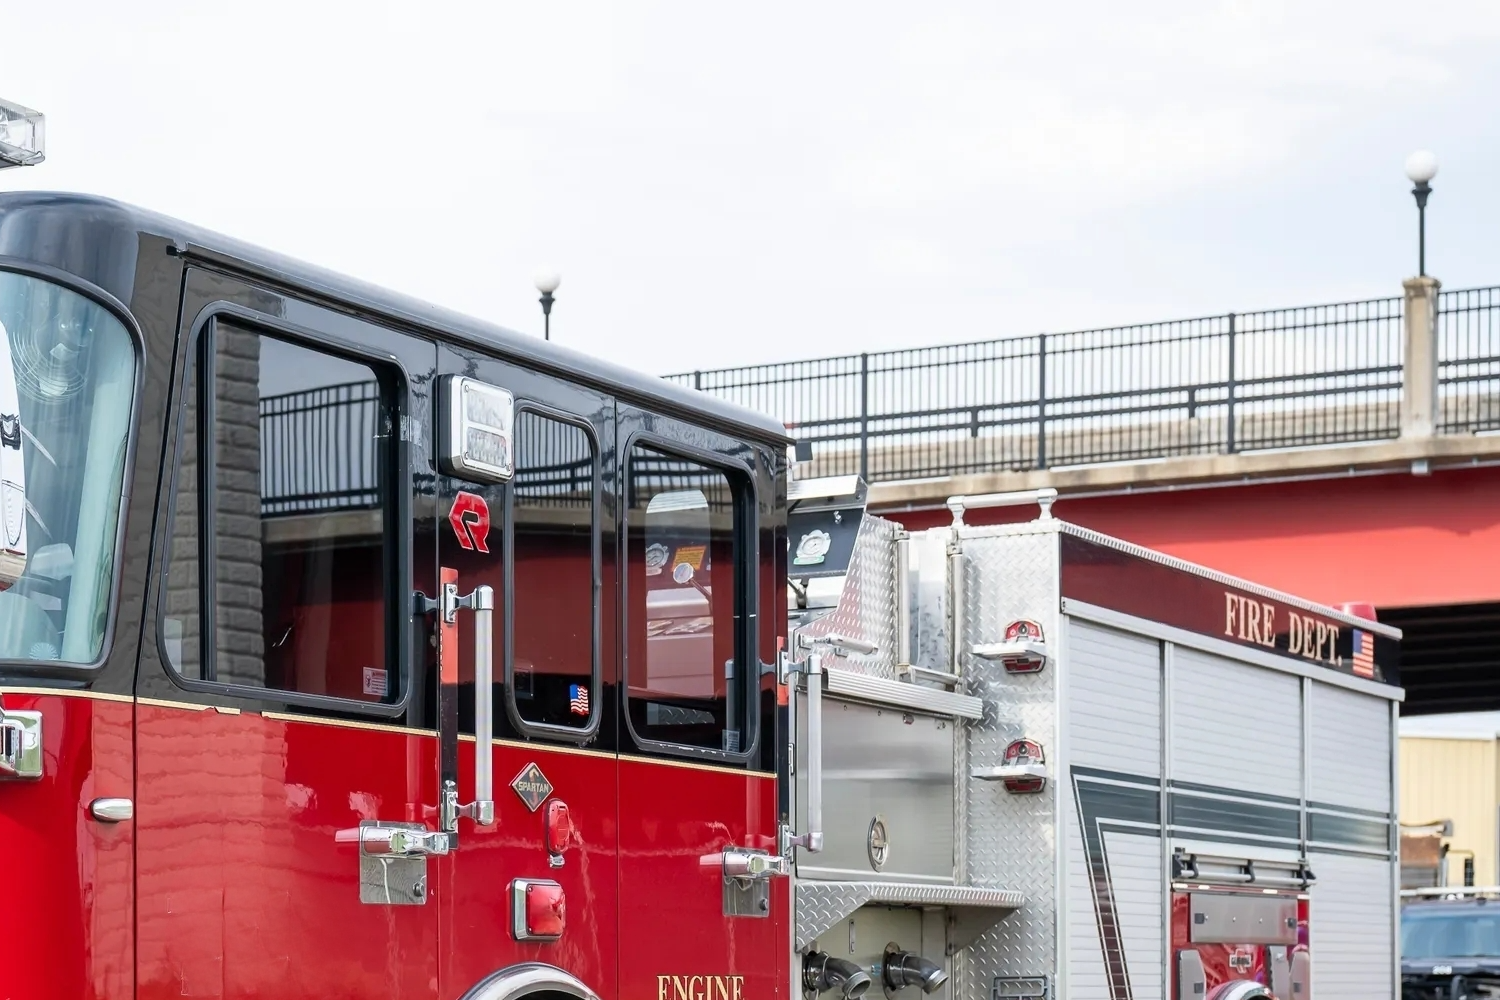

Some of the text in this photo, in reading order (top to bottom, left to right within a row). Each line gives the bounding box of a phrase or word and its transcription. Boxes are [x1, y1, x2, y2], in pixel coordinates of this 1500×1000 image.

[1224, 591, 1342, 667] FIRE DEPT.
[518, 781, 549, 793] SPARTAN
